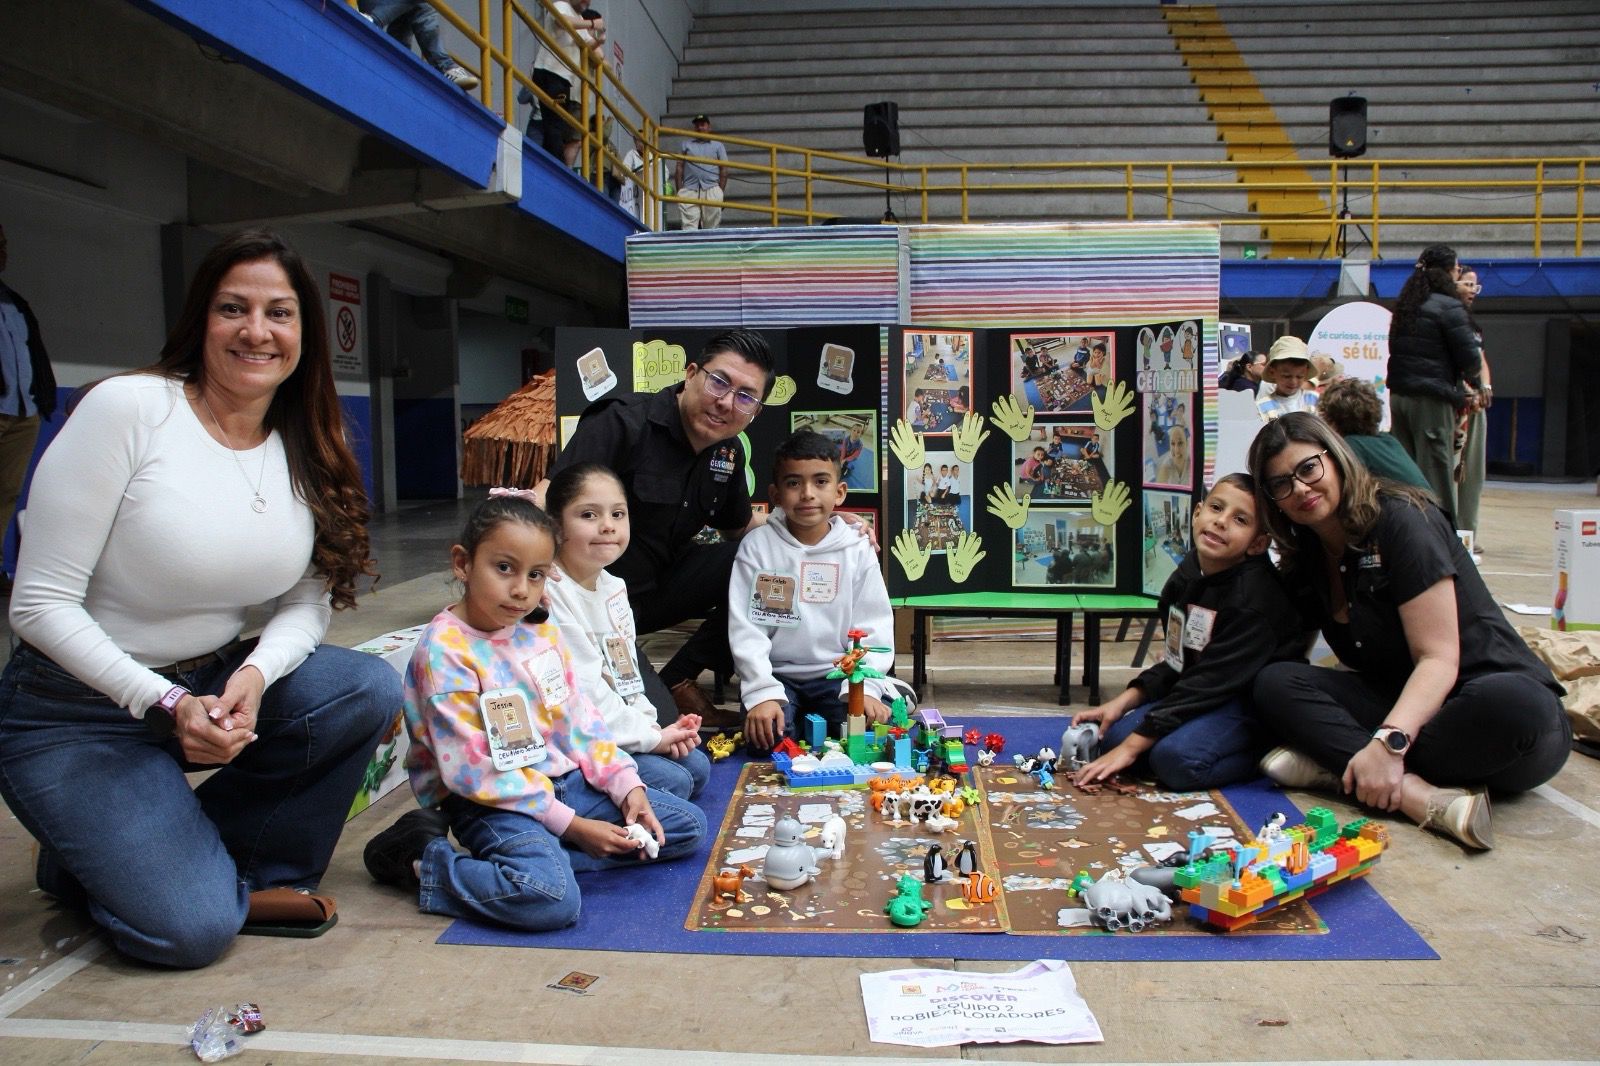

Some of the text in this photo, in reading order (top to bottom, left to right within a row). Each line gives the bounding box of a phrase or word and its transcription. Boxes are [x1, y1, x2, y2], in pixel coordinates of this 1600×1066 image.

[1318, 331, 1328, 340] Sé
[1363, 332, 1372, 341] sé
[1343, 342, 1382, 361] sé tú.
[929, 993, 1018, 1004] DISCOVER
[937, 1001, 1014, 1012] EQUIPO 2
[890, 1007, 1066, 1022] ROBIEXPLORADORES
